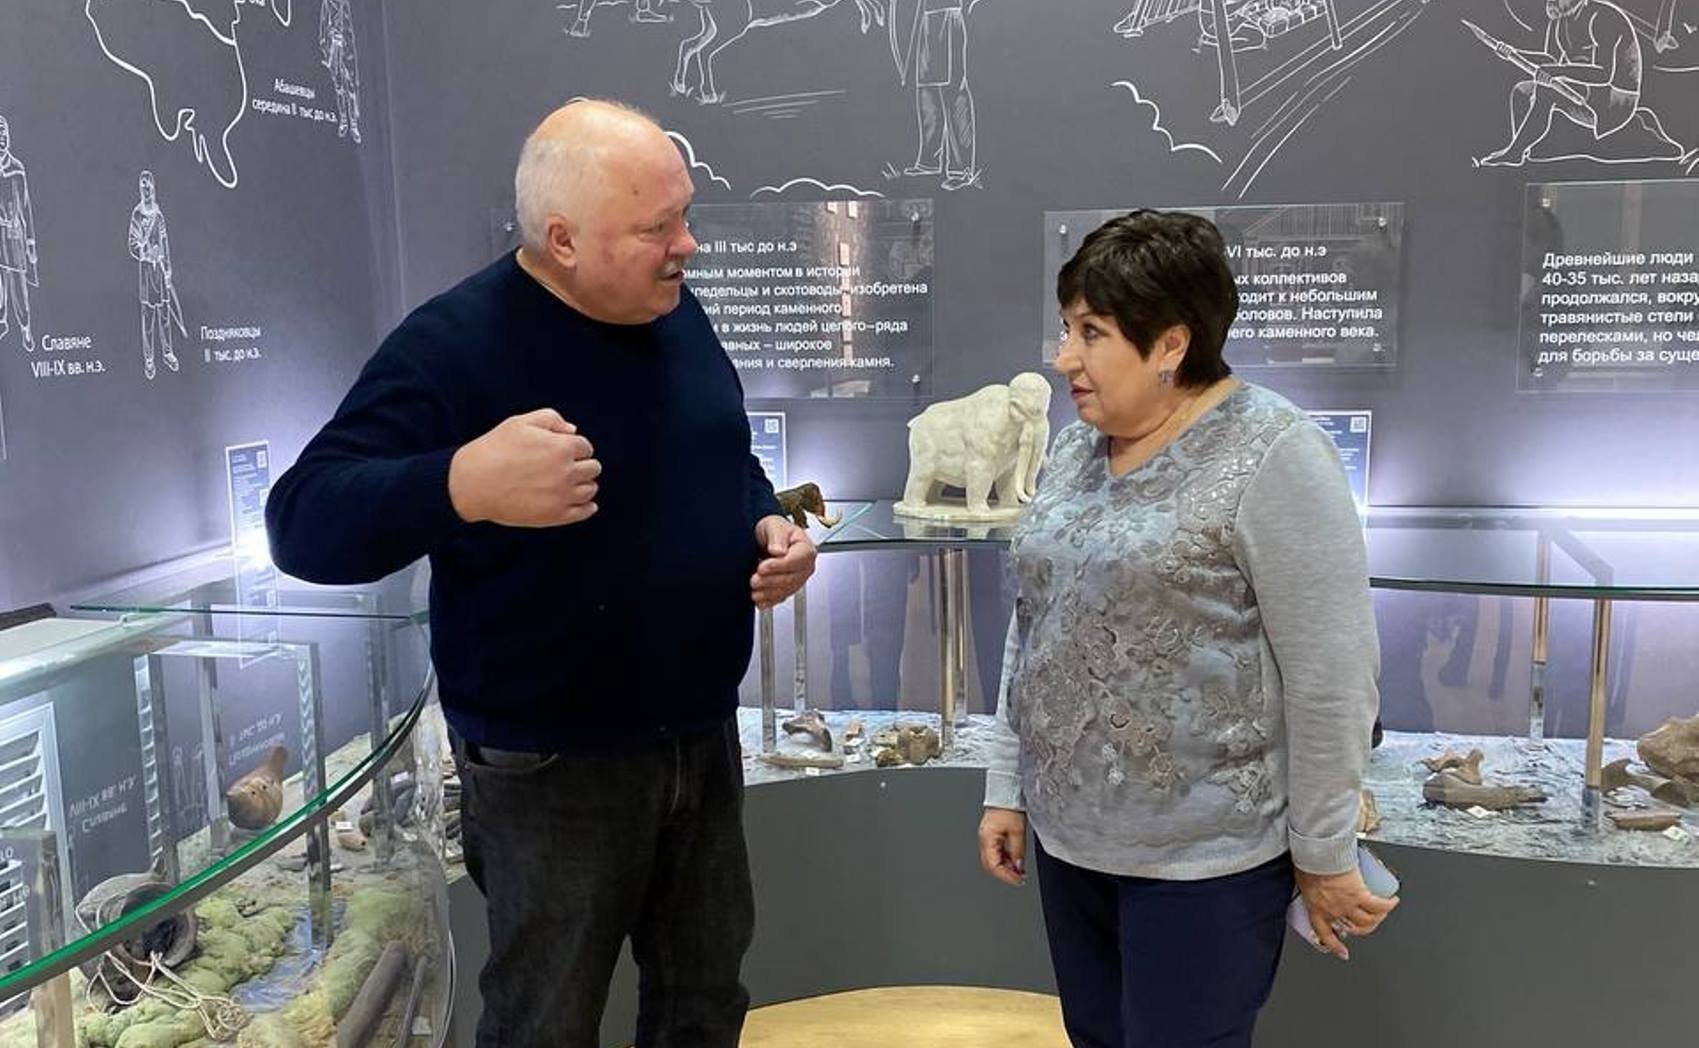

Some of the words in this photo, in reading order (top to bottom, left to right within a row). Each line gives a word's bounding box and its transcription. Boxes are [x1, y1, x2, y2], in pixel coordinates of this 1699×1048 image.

[252, 98, 291, 115] середина
[757, 241, 775, 255] до
[777, 240, 798, 253] н.э
[1246, 246, 1277, 259] тыс.
[1281, 245, 1300, 260] до
[1304, 245, 1327, 257] н.э
[1542, 251, 1646, 269] Древнейшие
[1650, 252, 1694, 266] люди
[727, 267, 793, 279] моментом
[795, 267, 803, 278] в
[806, 264, 861, 279] истории
[1253, 272, 1347, 286] коллективов
[1542, 270, 1587, 286] 40-35
[1591, 273, 1625, 286] тыс.
[1629, 272, 1657, 285] лет
[1661, 272, 1699, 284] наза
[761, 285, 771, 297] и
[850, 280, 928, 297] изобретена
[1238, 291, 1275, 305] одит
[1278, 291, 1288, 303] к
[1290, 287, 1378, 303] небольшим
[1541, 291, 1652, 307] продолжался,
[723, 303, 772, 316] период
[774, 303, 842, 315] каменного
[1301, 306, 1384, 323] Наступила
[1540, 311, 1644, 326] травянистые
[1647, 310, 1694, 323] степи
[200, 325, 261, 341] Поздняковцы
[721, 322, 730, 334] в
[732, 321, 772, 334] жизнь
[774, 319, 819, 334] людей
[1258, 326, 1337, 339] каменного
[1340, 325, 1379, 338] века.
[41, 334, 93, 352] Славяне
[775, 340, 832, 353] широкое
[1539, 331, 1648, 346] перелесками,
[1652, 331, 1673, 342] но
[233, 349, 245, 363] до
[765, 358, 774, 369] и
[777, 357, 846, 372] сверления
[850, 356, 895, 369] камня.
[1538, 351, 1568, 364] для
[1572, 348, 1633, 367] борьбы
[1636, 351, 1655, 363] за
[30, 359, 67, 379] VIII-IX
[85, 360, 106, 374] н.э.
